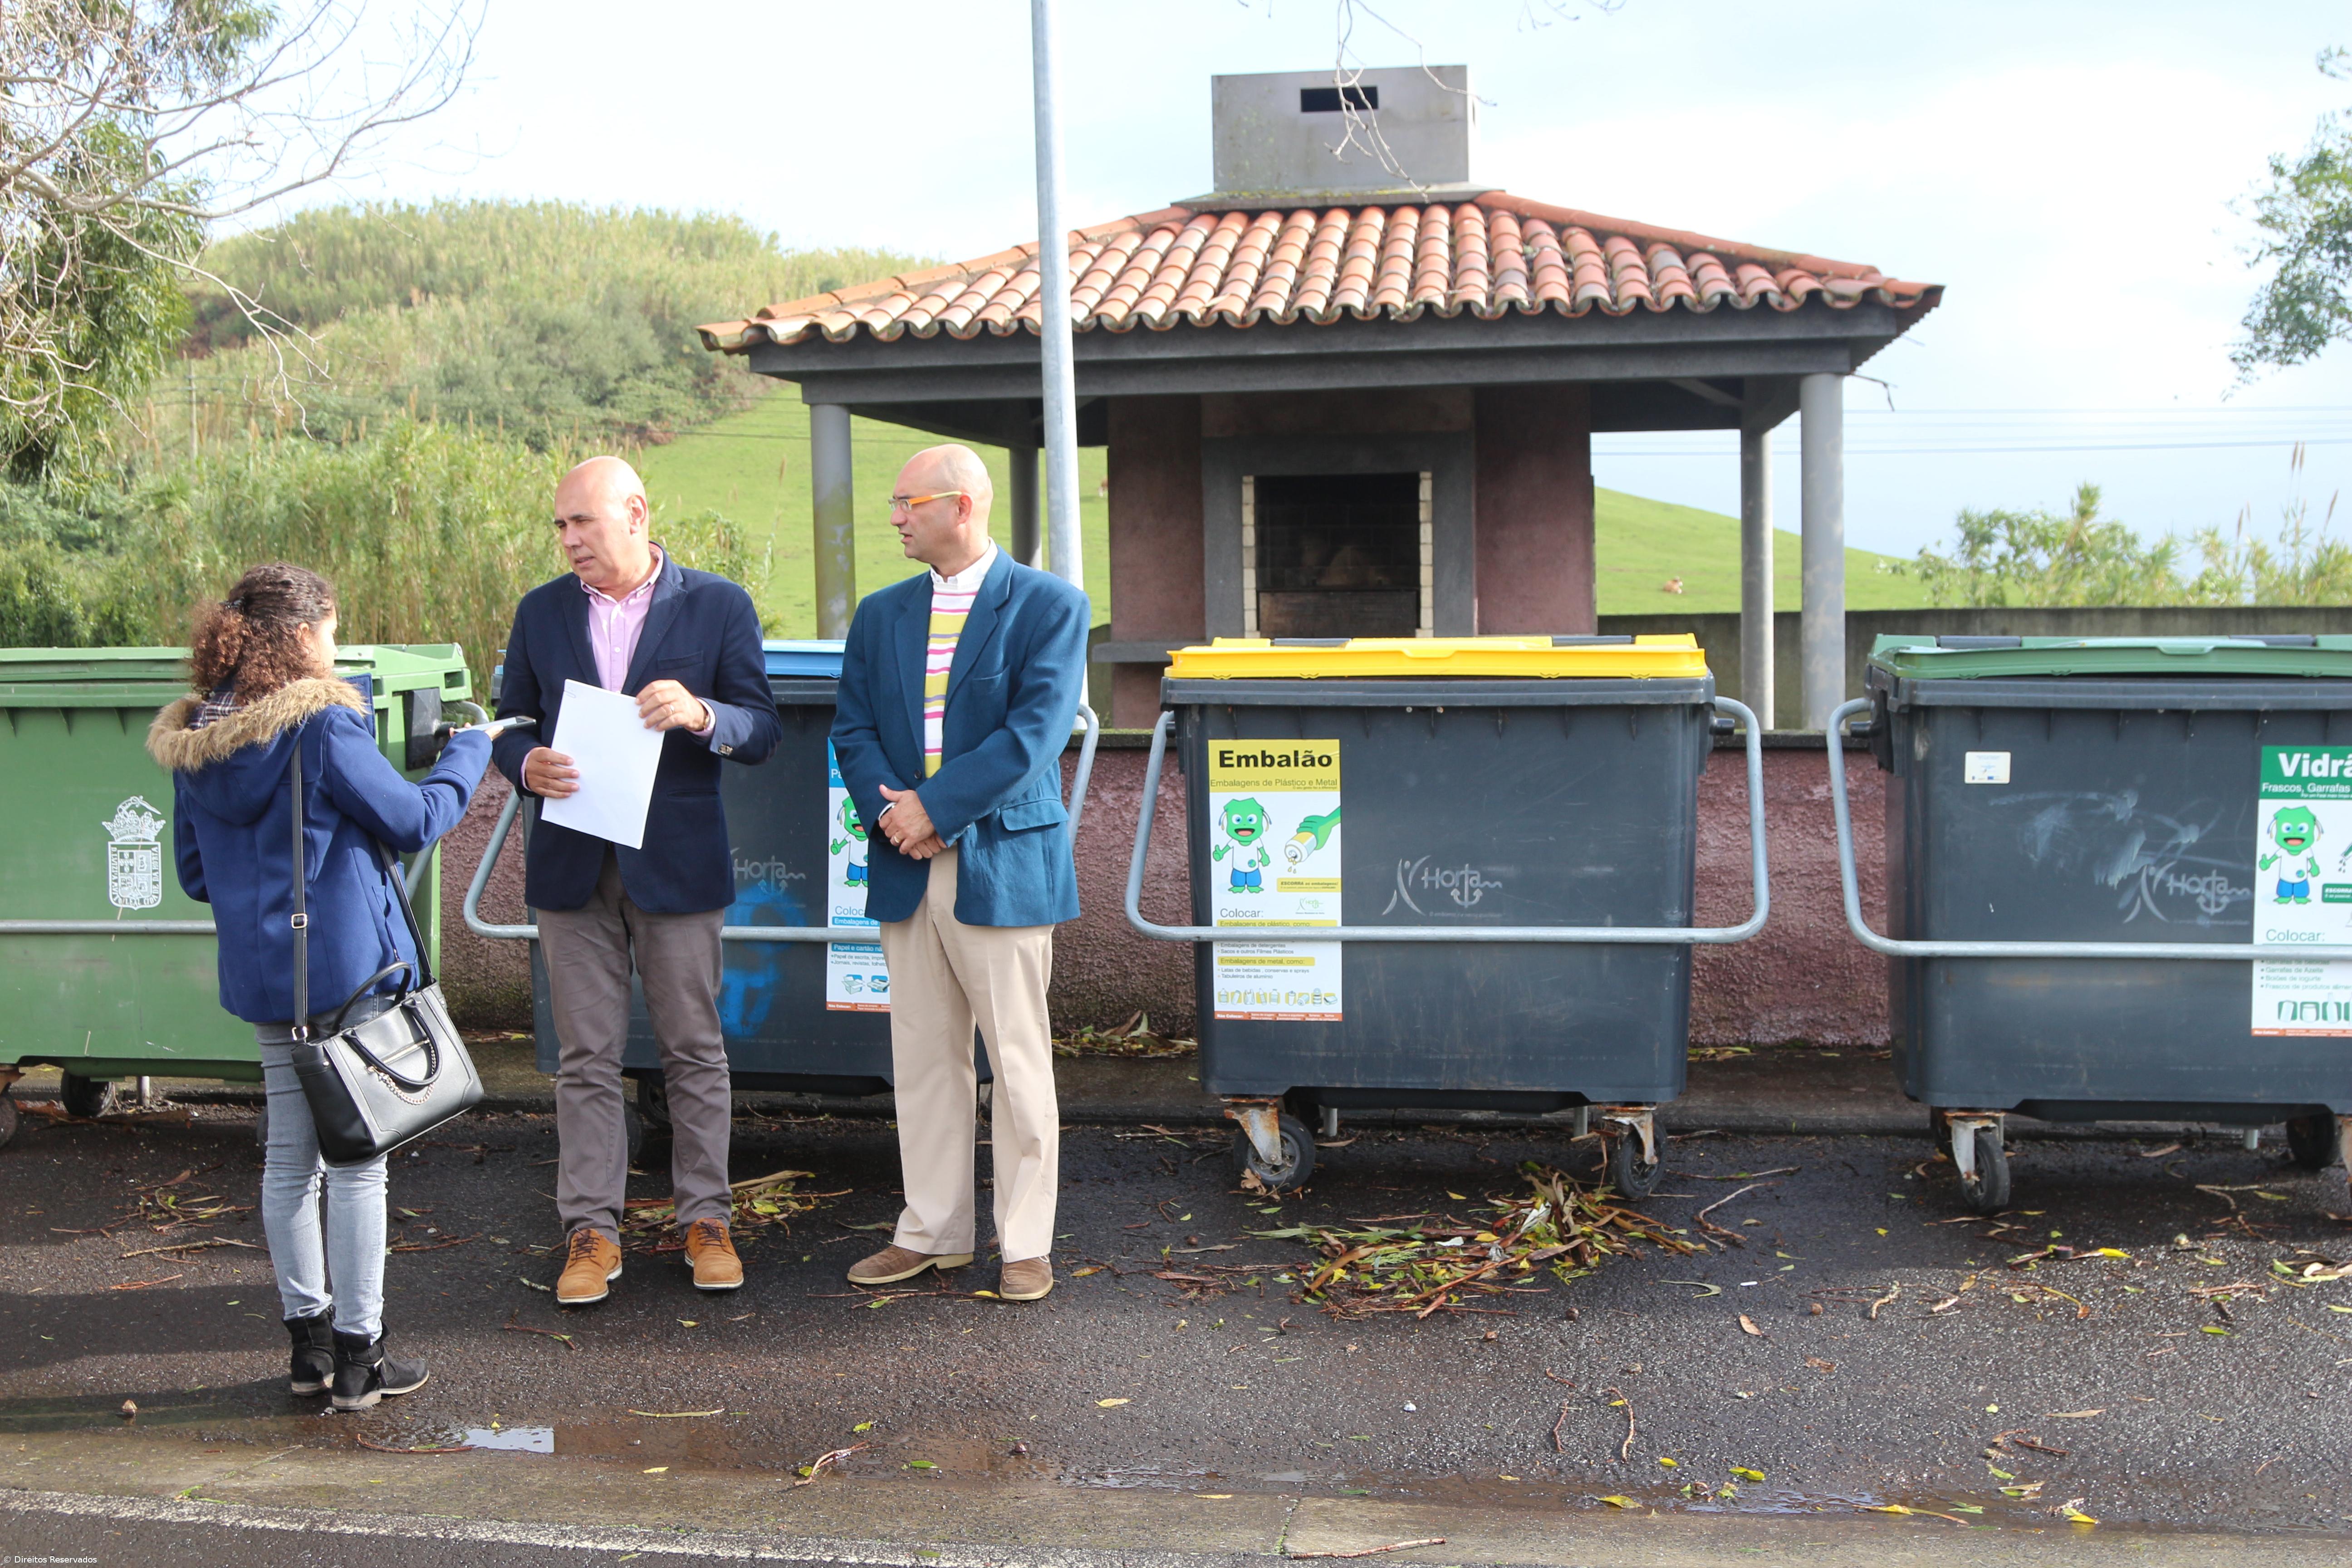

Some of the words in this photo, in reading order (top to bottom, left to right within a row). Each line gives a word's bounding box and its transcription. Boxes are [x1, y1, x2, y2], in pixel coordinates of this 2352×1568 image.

[1219, 750, 1332, 768] Embalão
[1210, 779, 1260, 788] Embalagens
[1275, 778, 1306, 786] Plástico
[1316, 778, 1338, 786] Metal
[2262, 782, 2304, 794] Frascos,
[2307, 782, 2351, 793] Garrafas
[1220, 908, 1263, 918] Colocar:
[2266, 929, 2325, 942] Colocar:
